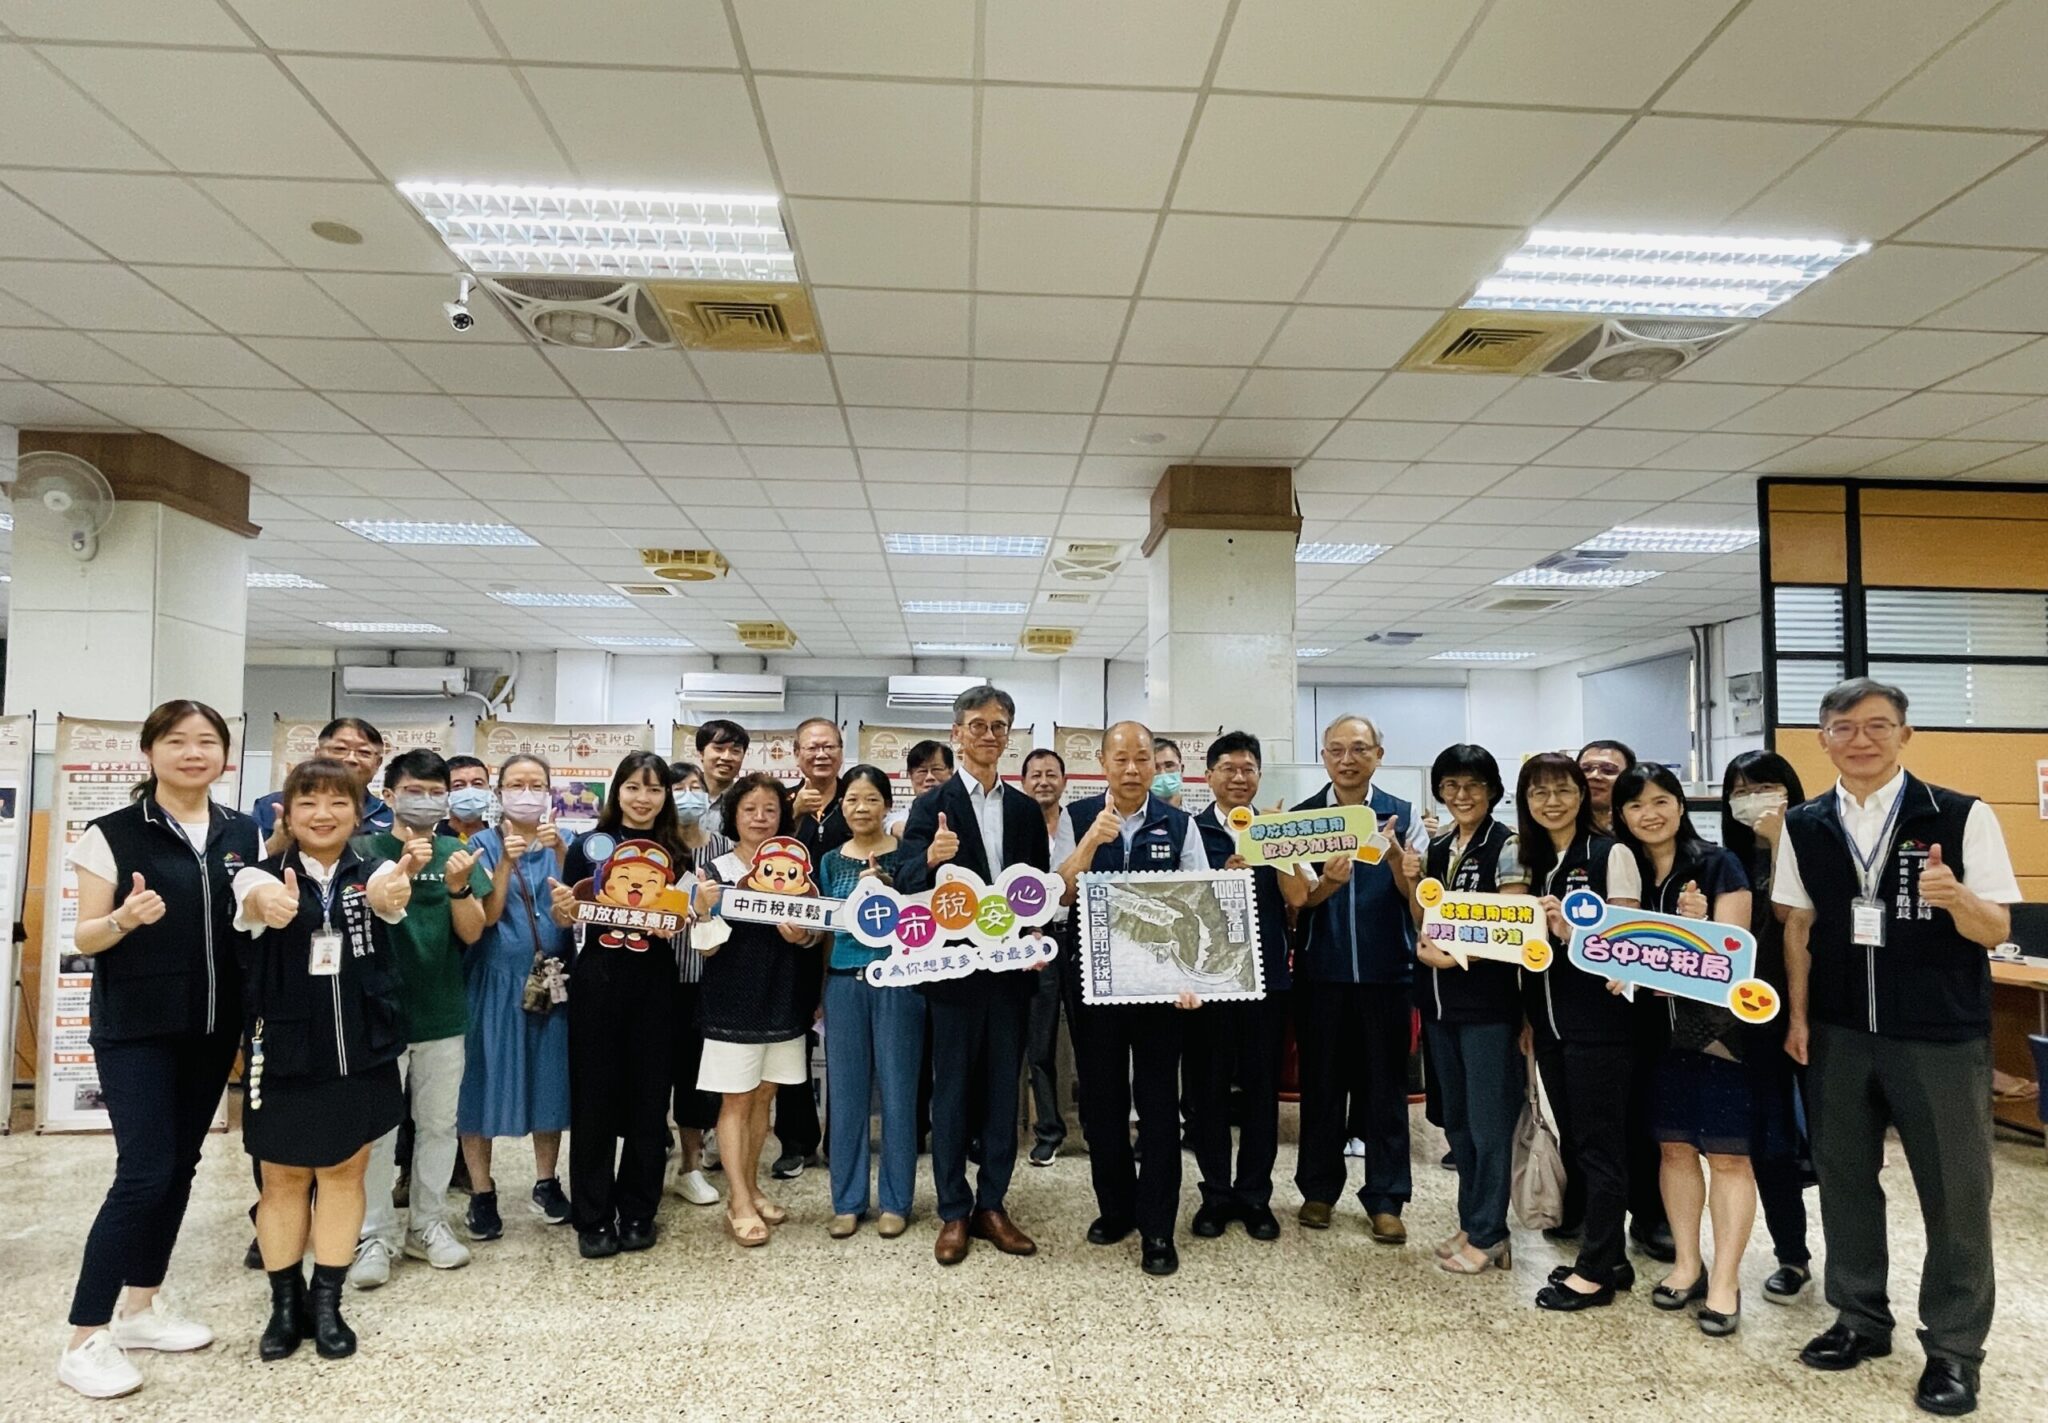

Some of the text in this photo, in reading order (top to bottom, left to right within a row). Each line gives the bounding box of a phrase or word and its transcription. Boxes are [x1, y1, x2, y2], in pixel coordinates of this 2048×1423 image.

[1250, 816, 1345, 841] 開放檔案應用
[1263, 834, 1358, 860] 歡迎多加利用
[577, 903, 678, 930] 開放檔案應用
[734, 896, 821, 920] 中市稅輕鬆
[864, 885, 1043, 941] 中市稅安心
[1440, 902, 1534, 924] 檔案應用服務
[1582, 933, 1733, 983] 台中地稅局
